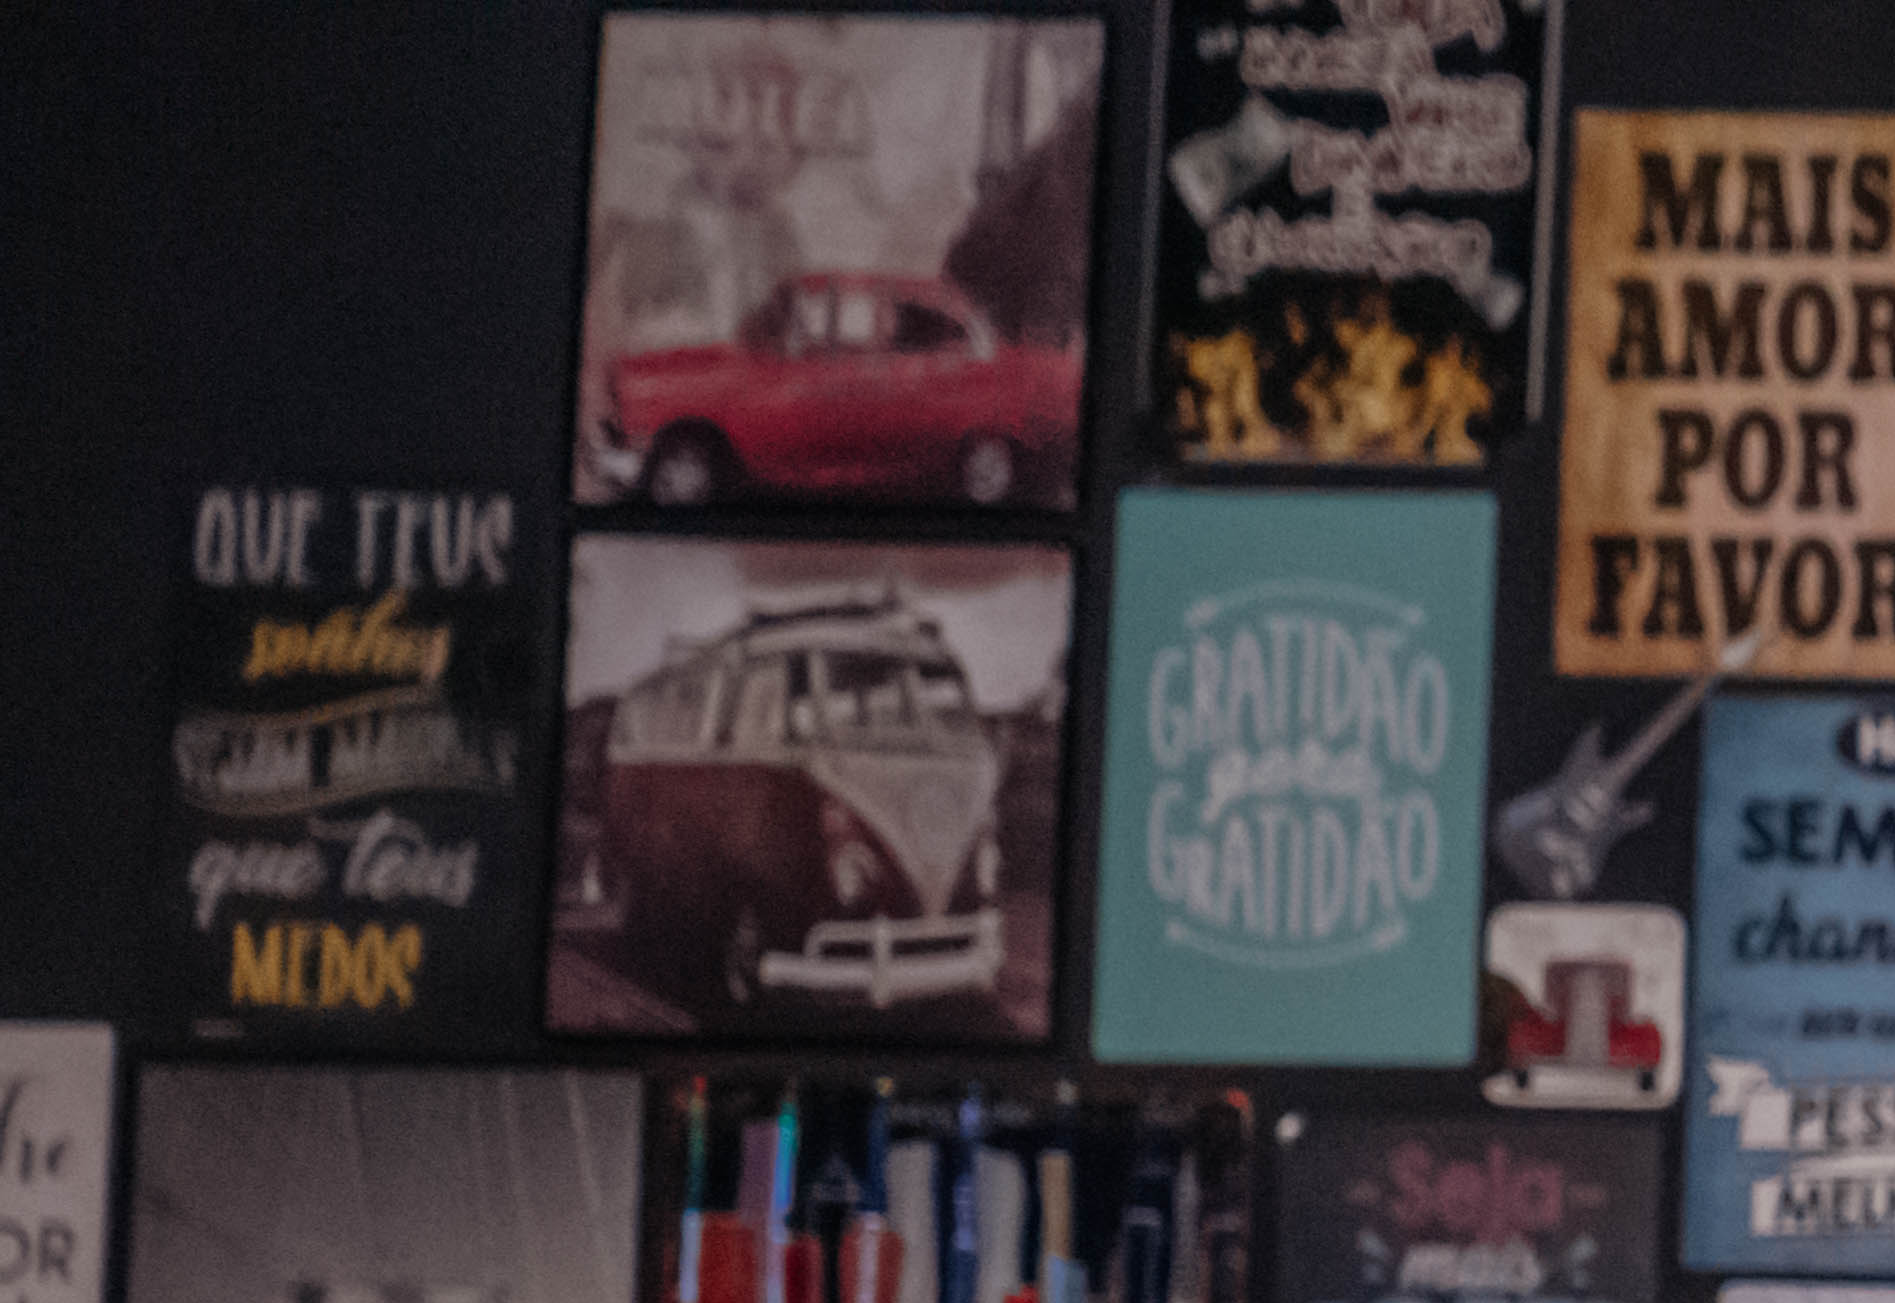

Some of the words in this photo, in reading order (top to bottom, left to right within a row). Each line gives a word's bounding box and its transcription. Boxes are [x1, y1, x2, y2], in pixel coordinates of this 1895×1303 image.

[1636, 151, 1895, 256] MAIS
[1655, 407, 1858, 515] POR
[195, 486, 320, 589] QUE
